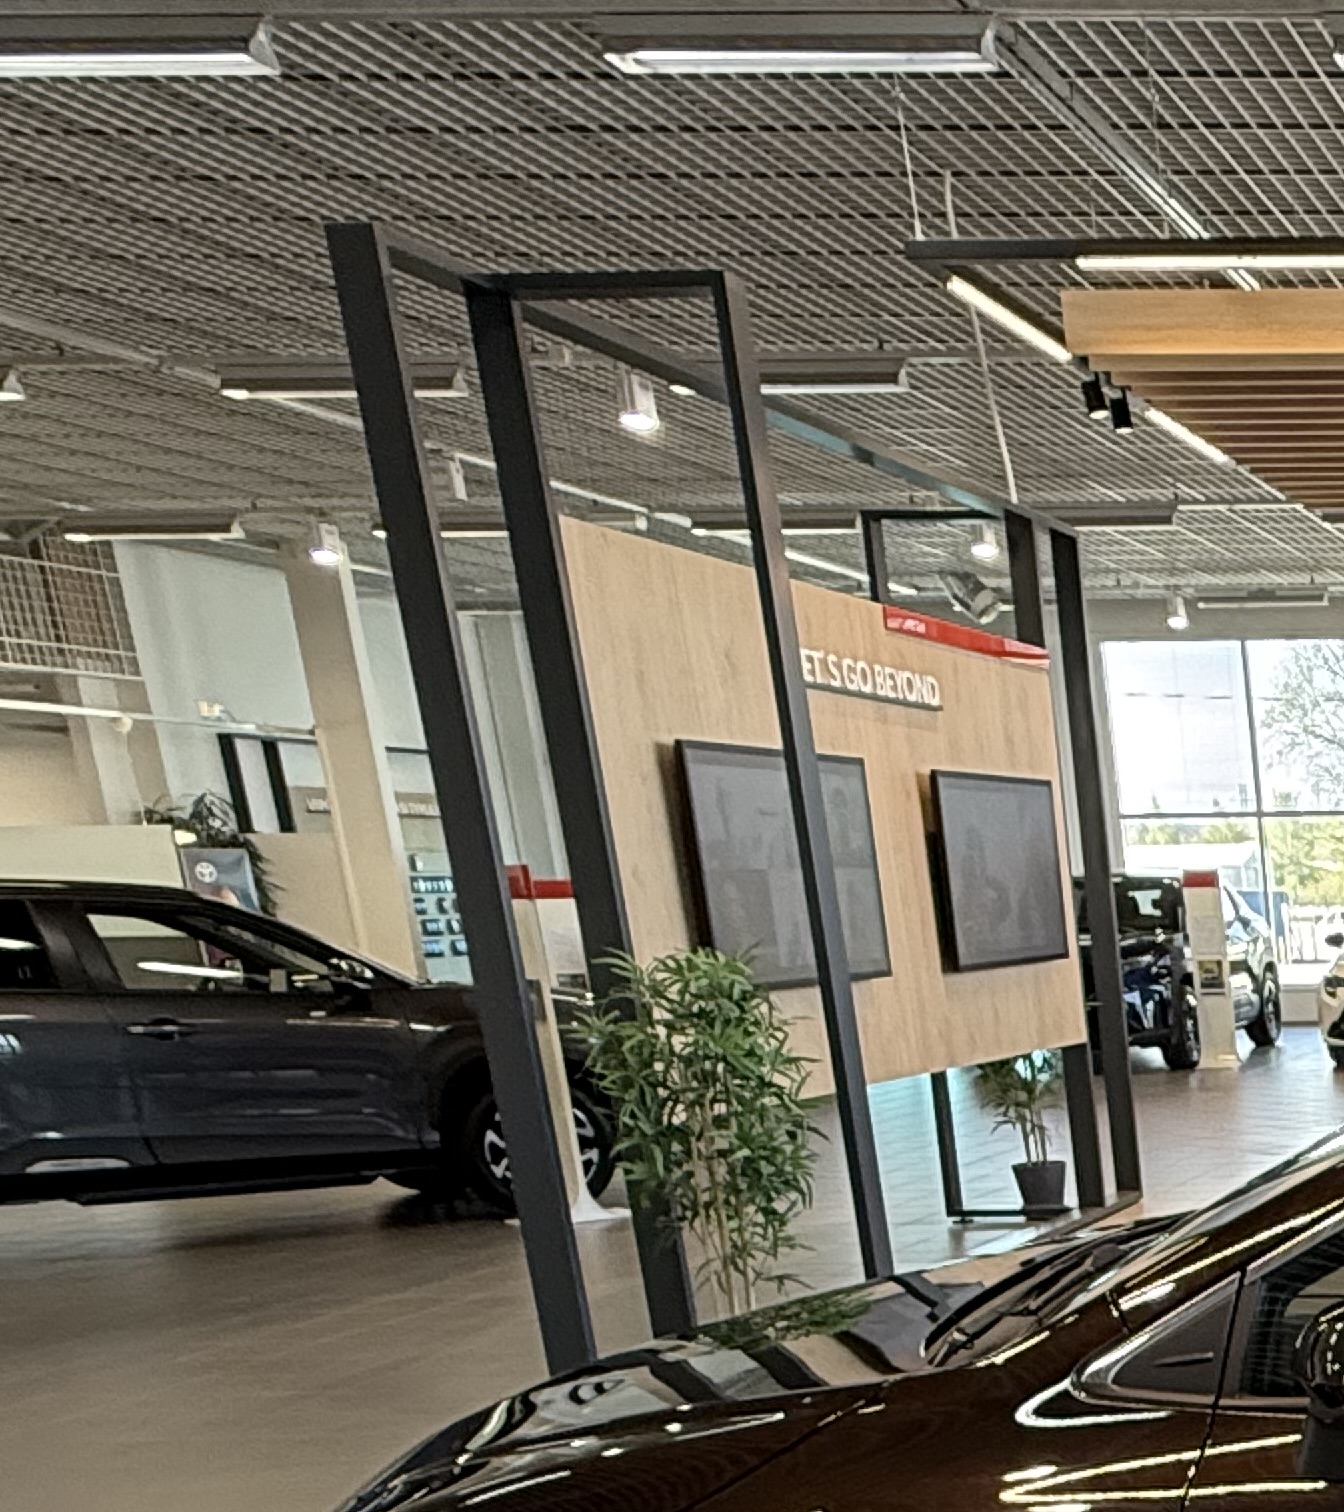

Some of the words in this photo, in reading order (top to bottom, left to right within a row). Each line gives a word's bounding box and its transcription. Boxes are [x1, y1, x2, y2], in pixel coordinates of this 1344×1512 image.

[800, 648, 841, 687] ET'S
[842, 658, 872, 693] GO
[873, 664, 940, 706] BEYOND
